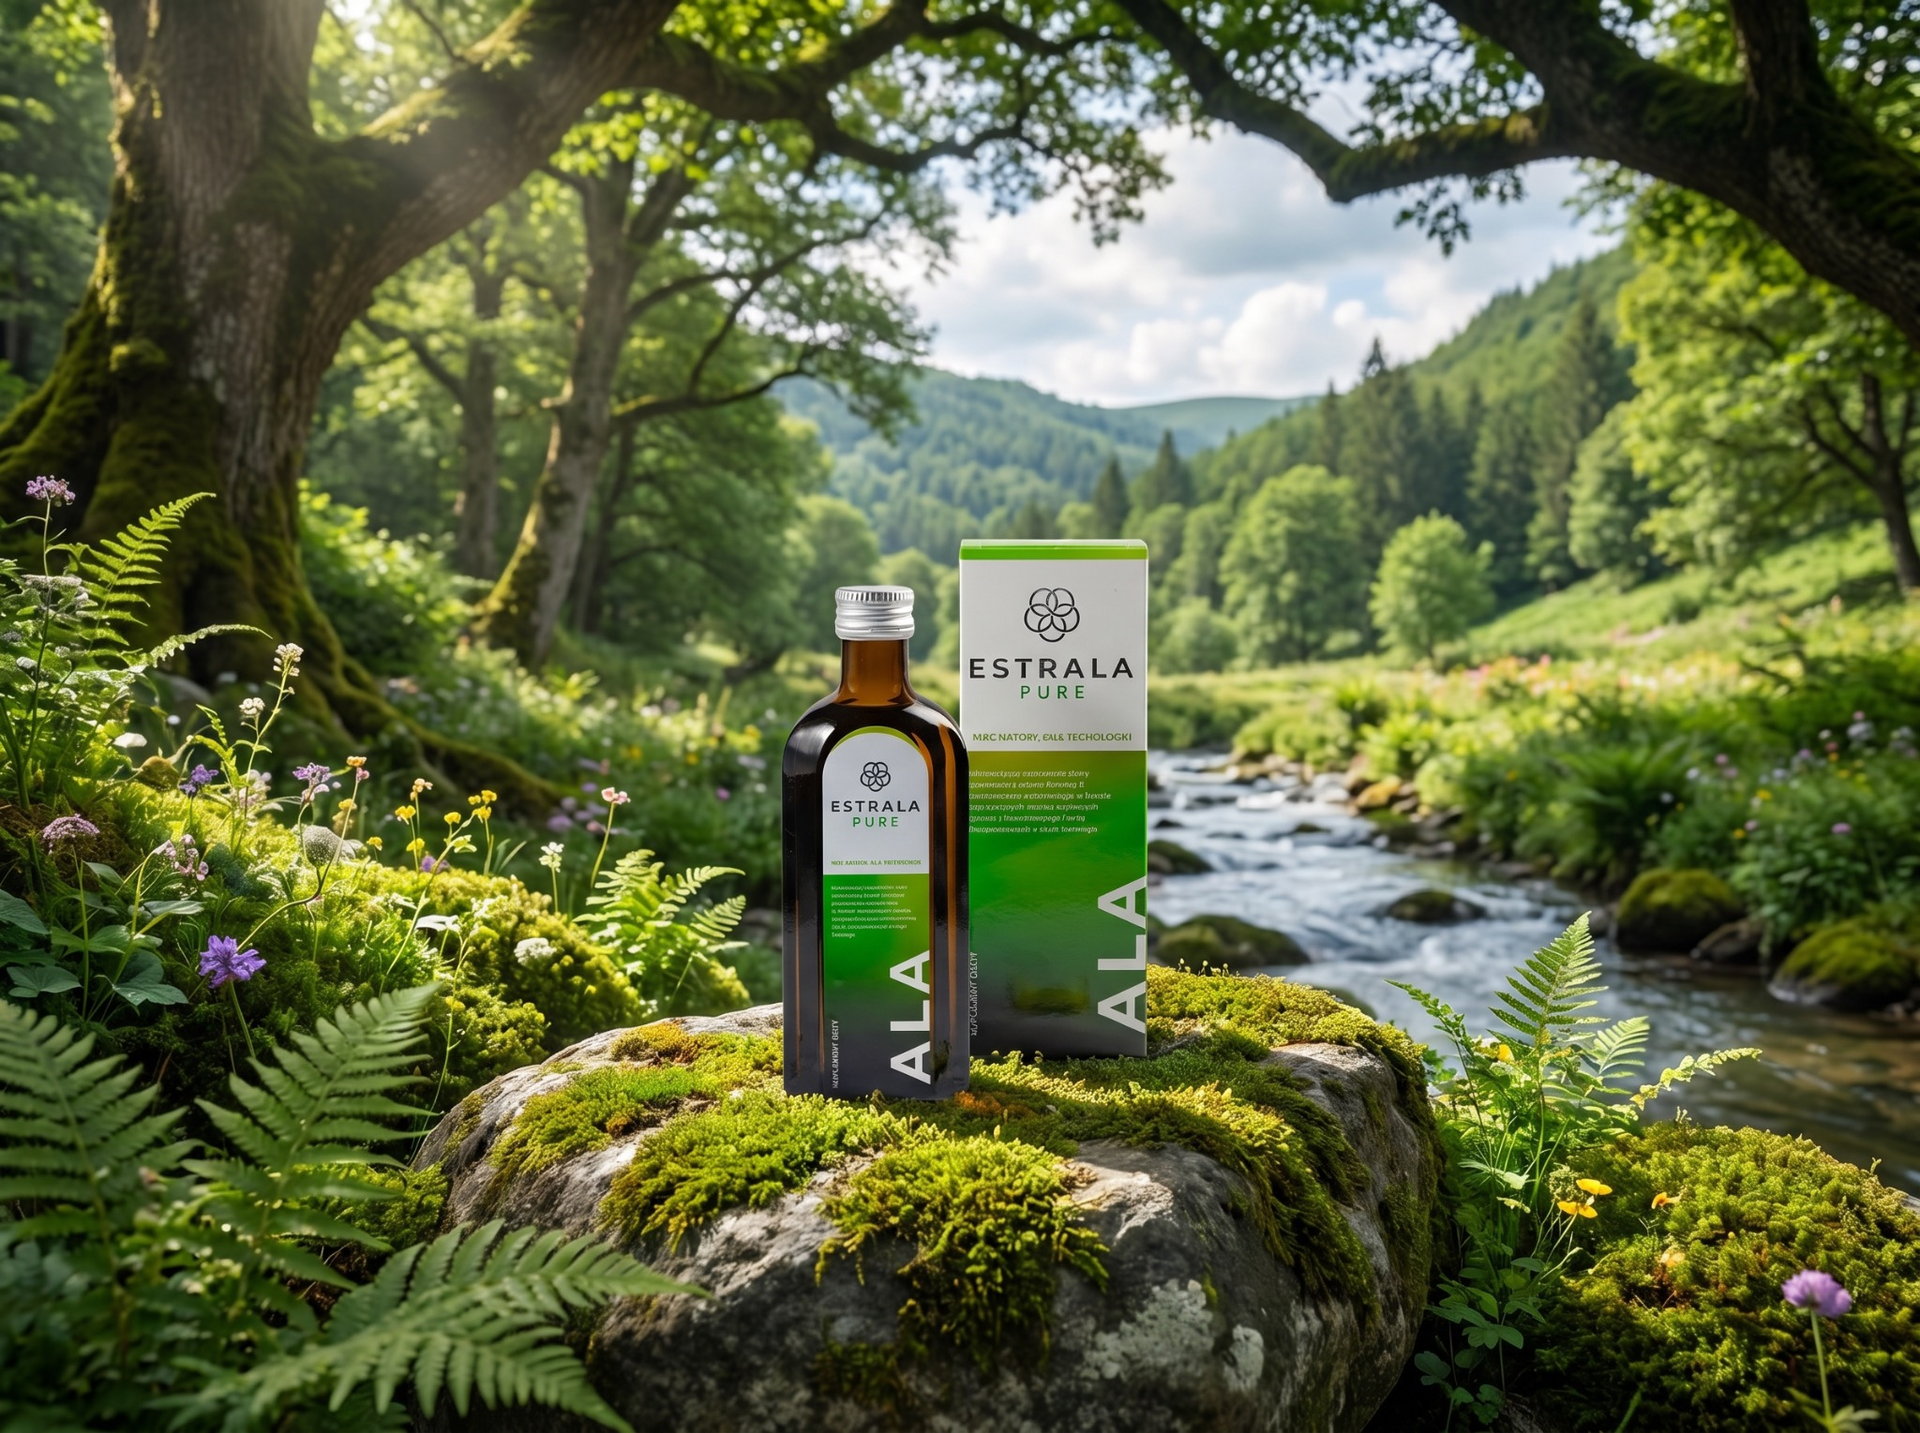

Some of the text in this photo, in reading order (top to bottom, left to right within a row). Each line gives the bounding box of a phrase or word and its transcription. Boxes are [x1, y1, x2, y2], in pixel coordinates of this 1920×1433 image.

[969, 658, 1134, 679] ESTRALA
[1020, 685, 1085, 700] PURE
[1066, 732, 1133, 742] TECHOLOGKI
[831, 800, 921, 813] ESTRALA
[852, 816, 899, 828] PURE
[1097, 875, 1147, 1034] ALA
[889, 949, 931, 1086] ALA
